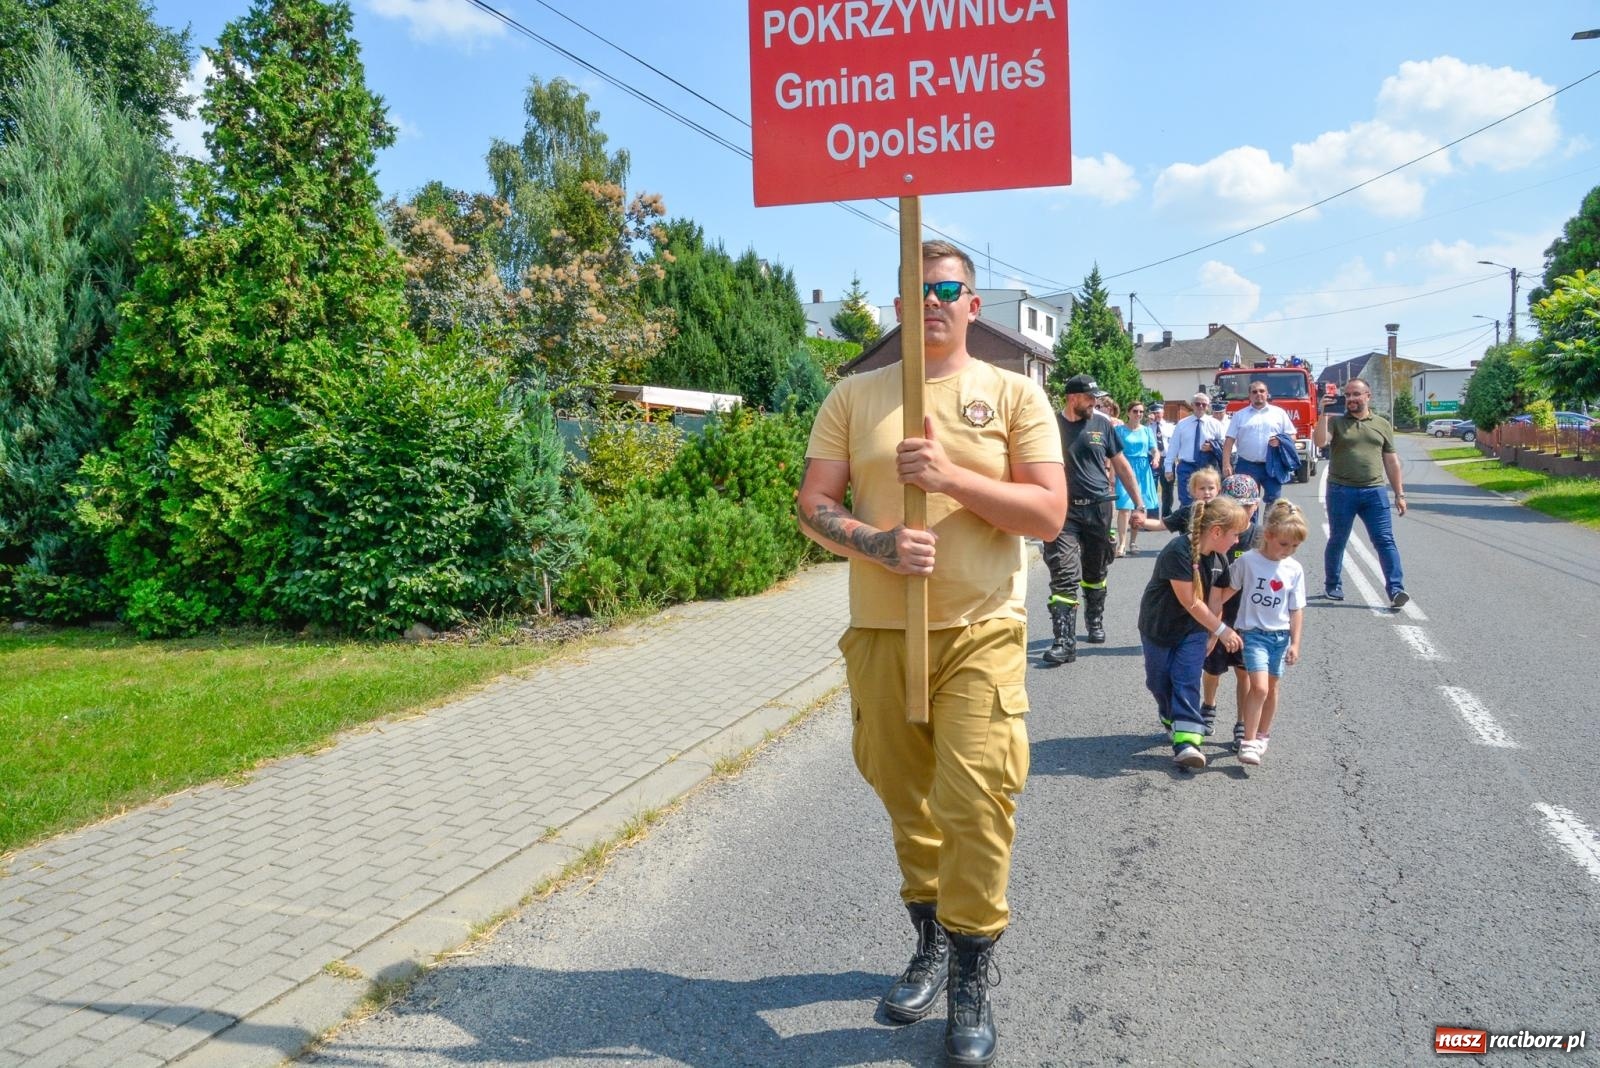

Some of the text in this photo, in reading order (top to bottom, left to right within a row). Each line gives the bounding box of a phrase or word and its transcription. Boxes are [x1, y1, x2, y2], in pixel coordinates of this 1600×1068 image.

[775, 49, 1046, 110] Gmina R-Wieś
[826, 113, 995, 168] Opolskie
[1251, 593, 1281, 608] OSP
[1256, 578, 1266, 590] I
